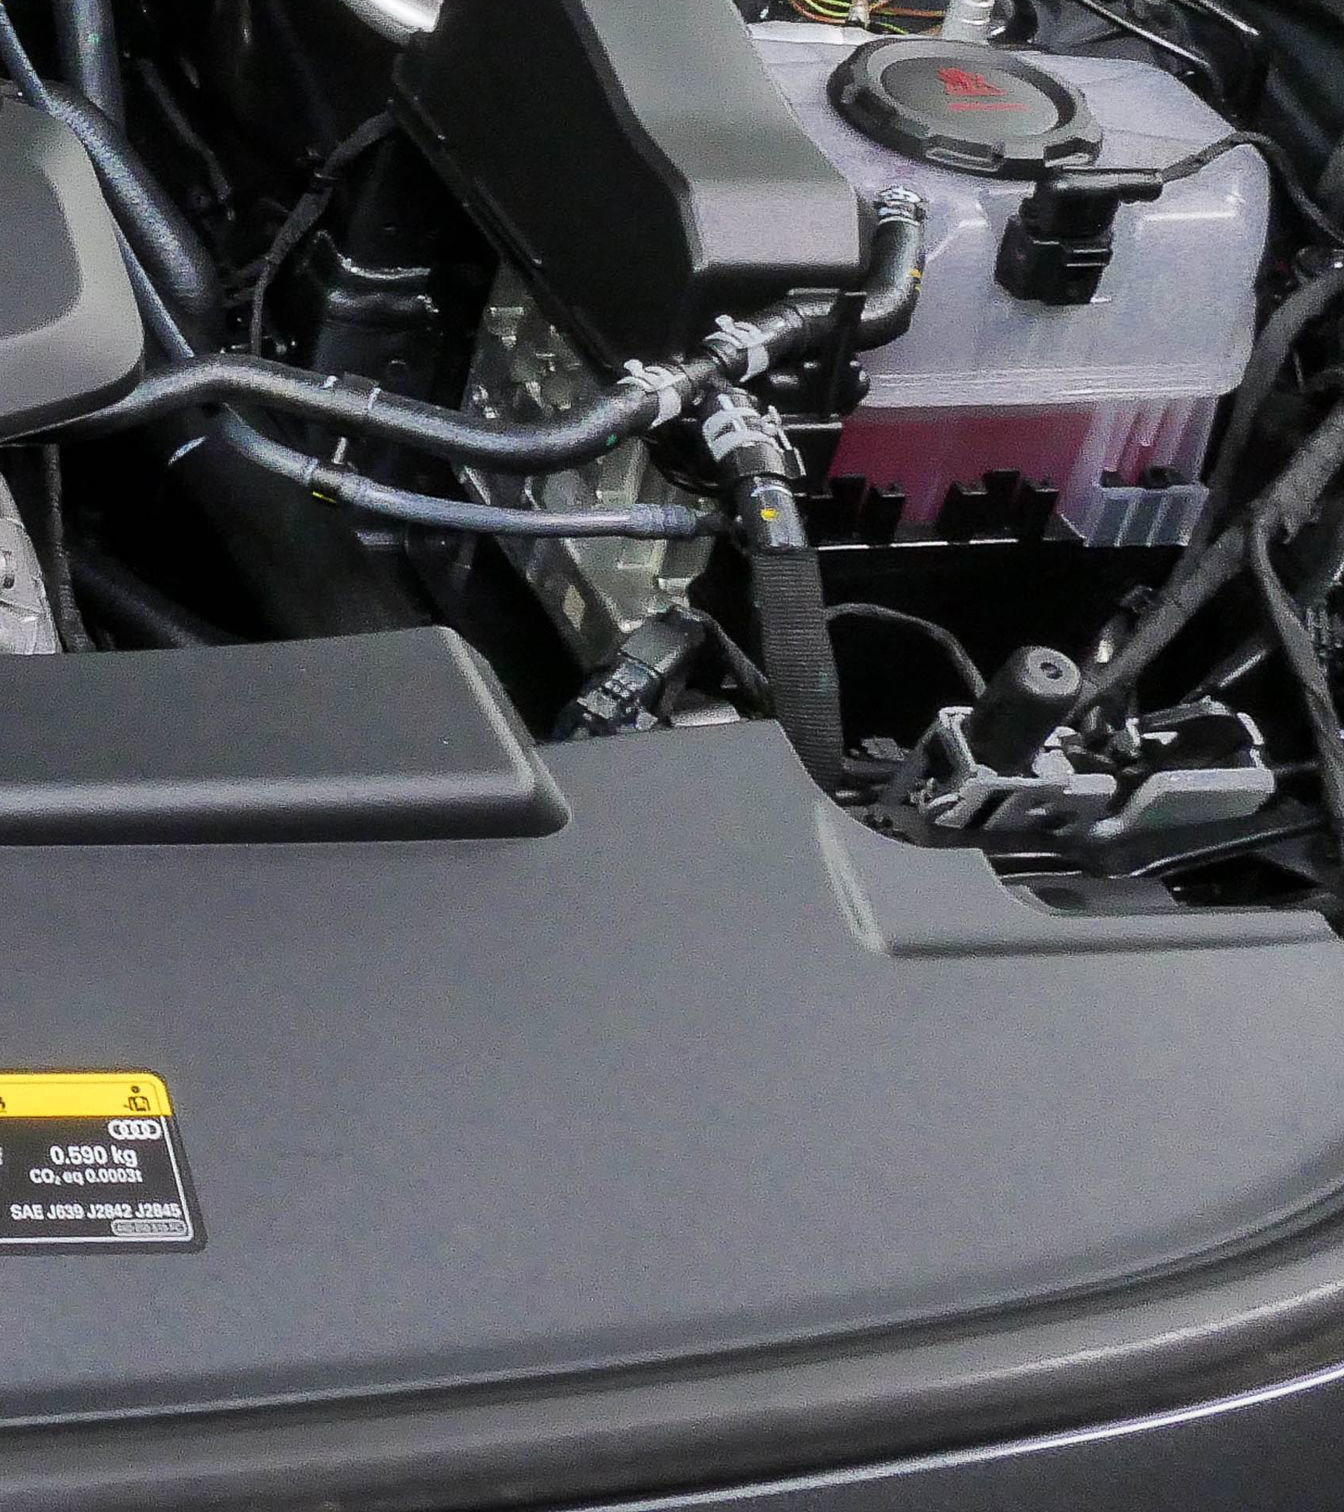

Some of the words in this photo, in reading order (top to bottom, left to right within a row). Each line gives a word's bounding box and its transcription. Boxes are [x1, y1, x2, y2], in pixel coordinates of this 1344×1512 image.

[50, 1145, 108, 1164] 0.590
[111, 1144, 138, 1167] kg
[10, 1204, 44, 1220] SAE
